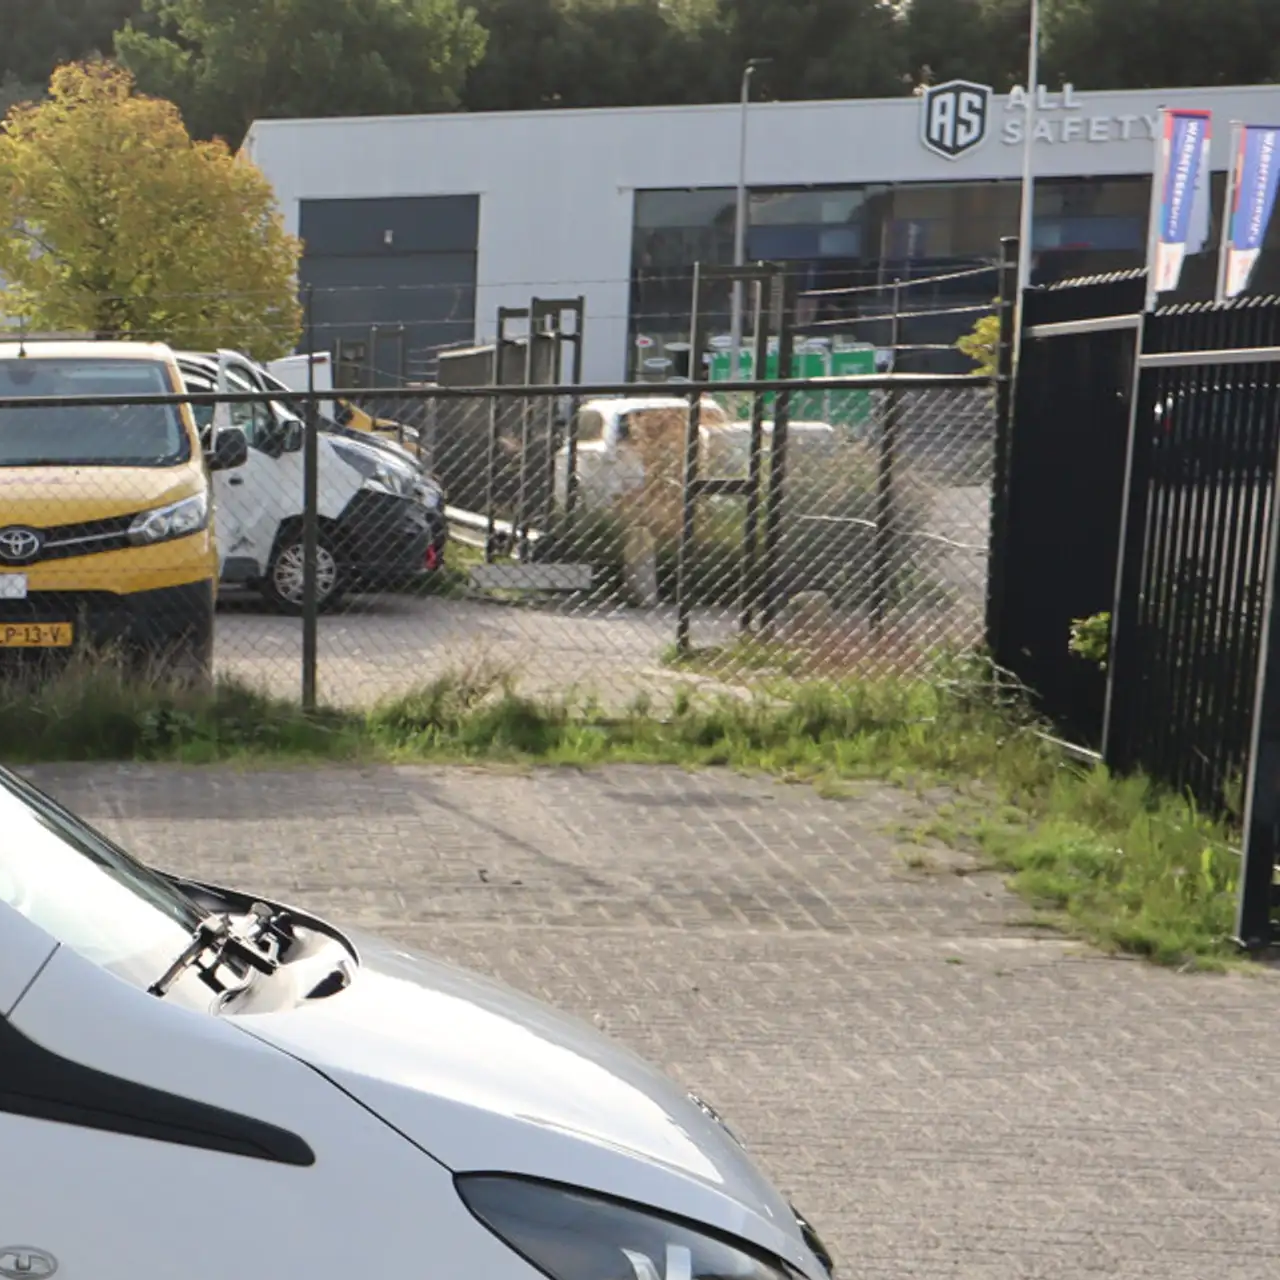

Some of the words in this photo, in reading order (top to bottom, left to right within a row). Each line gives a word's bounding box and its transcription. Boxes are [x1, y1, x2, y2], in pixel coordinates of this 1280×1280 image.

[1006, 83, 1082, 110] ALL
[930, 91, 982, 148] AS
[1001, 114, 1163, 145] SAFETY
